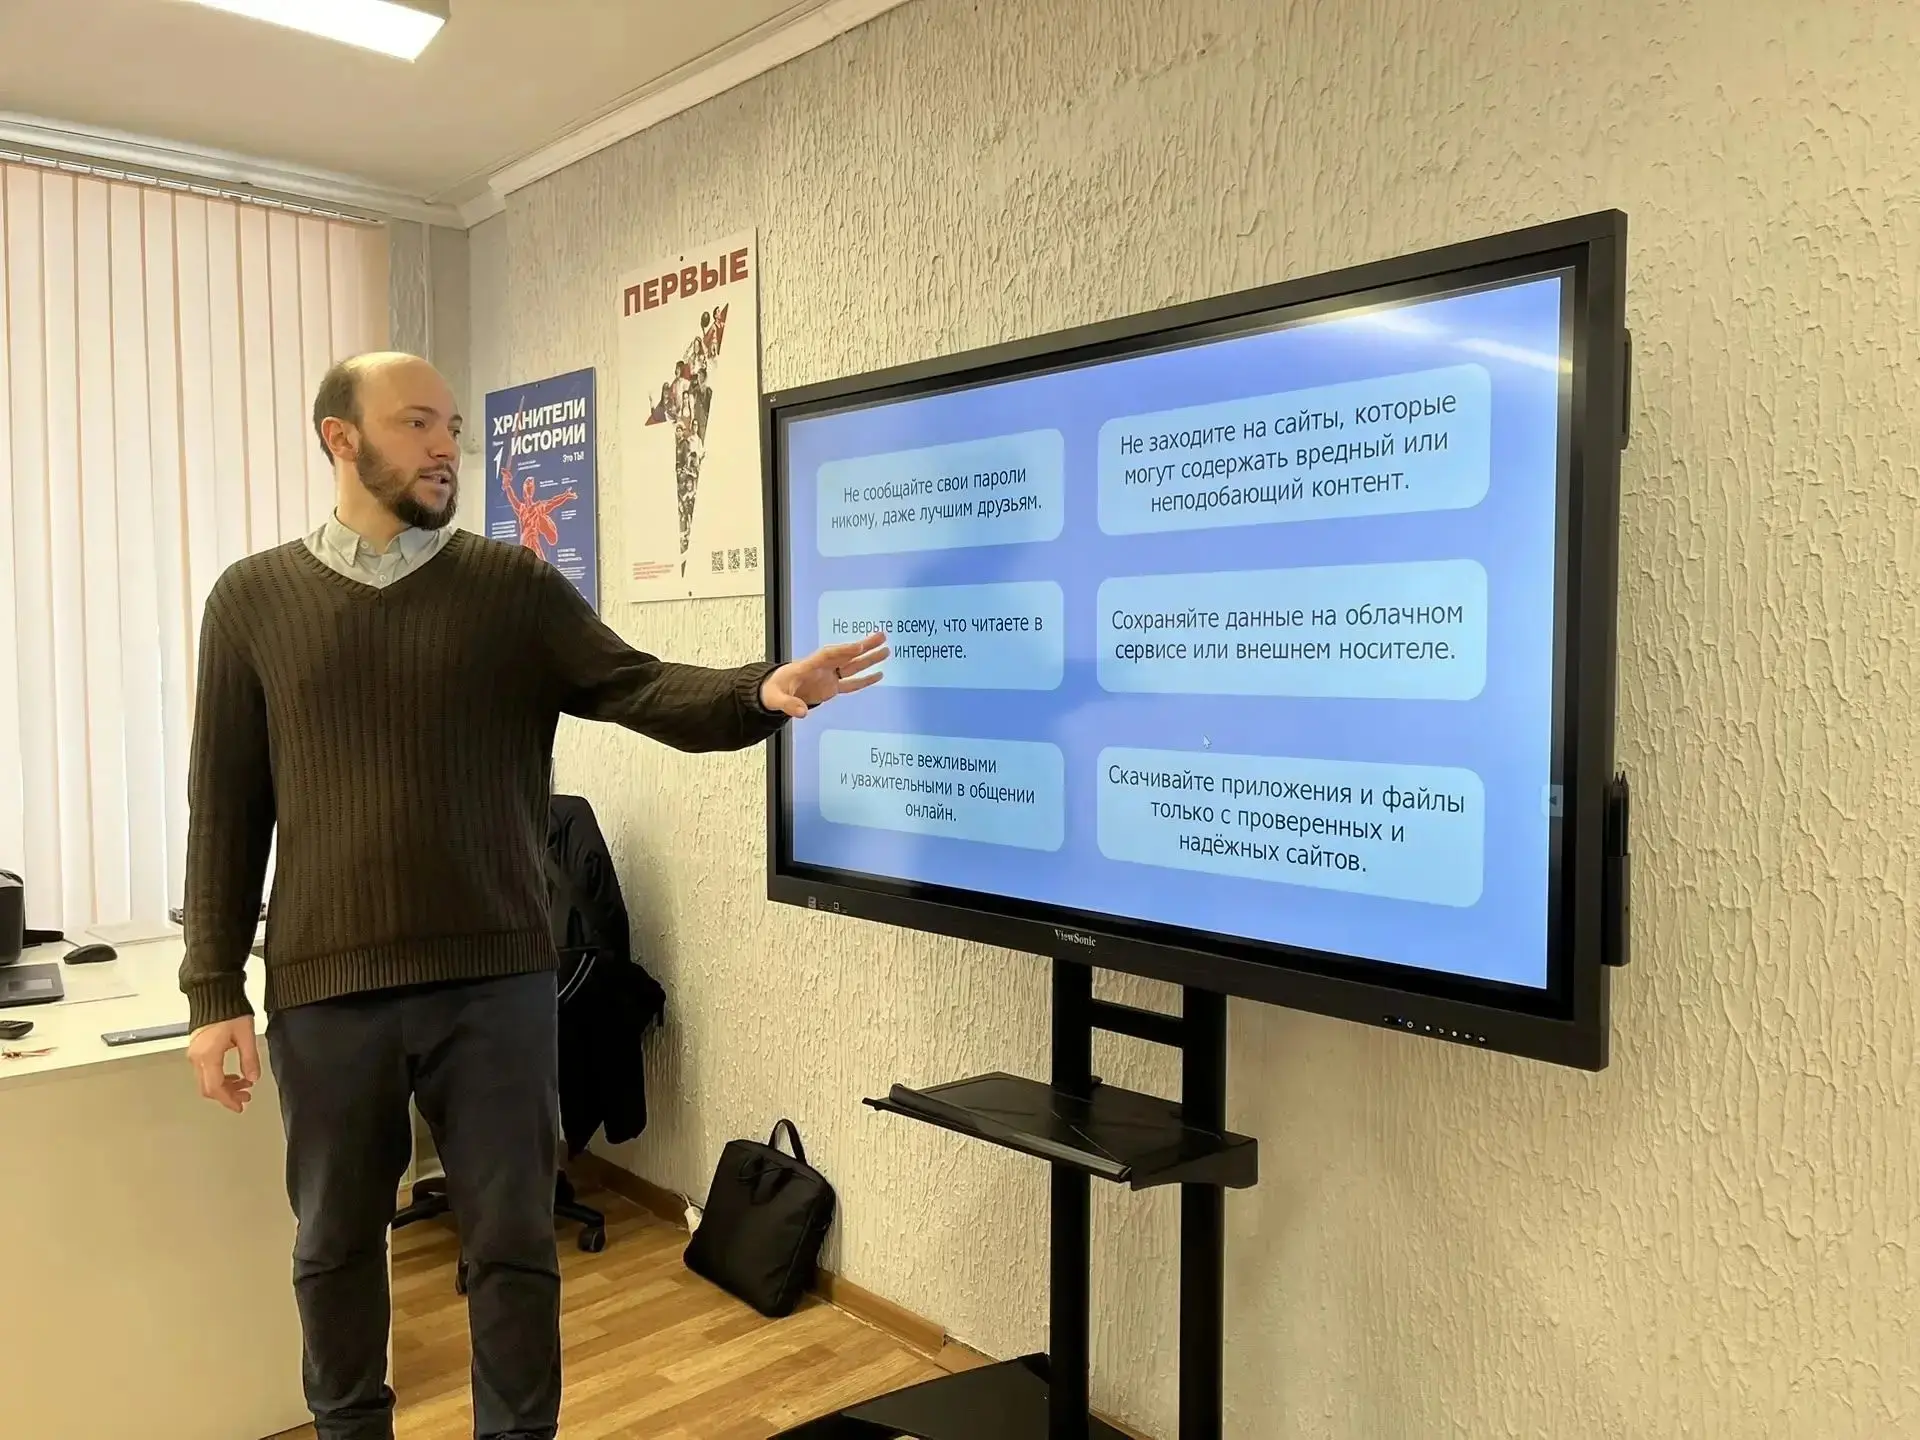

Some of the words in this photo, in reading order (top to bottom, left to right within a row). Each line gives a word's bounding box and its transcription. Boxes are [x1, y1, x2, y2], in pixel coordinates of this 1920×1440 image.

[624, 247, 748, 318] ПЕРВЫЕ
[492, 397, 586, 436] ХРАНИТЕЛИ
[1121, 434, 1144, 456] Не
[1149, 424, 1236, 453] заходите
[1243, 420, 1267, 440] на
[1274, 409, 1345, 436] сайты,
[1355, 394, 1457, 425] которые
[510, 422, 586, 458] ИСТОРИИ
[1125, 463, 1176, 488] могут
[1181, 451, 1289, 480] содержать
[1296, 432, 1395, 470] вредный
[1404, 431, 1448, 455] или
[844, 487, 860, 504] Не
[863, 478, 933, 503] сообщайте
[937, 476, 968, 493] свои
[973, 467, 1027, 492] пароли
[1151, 477, 1304, 513] неподобающий
[1312, 472, 1411, 498] контент.
[831, 512, 879, 530] никому,
[882, 508, 915, 527] даже
[919, 503, 973, 523] лучшим
[977, 495, 1042, 519] друзьям.
[832, 617, 848, 634] Не
[852, 619, 893, 636] верьте
[897, 619, 938, 638] всему,
[943, 618, 967, 633] что
[971, 616, 1029, 633] читаете
[1034, 617, 1043, 632] в
[1111, 608, 1219, 635] Сохраняйте
[1225, 608, 1304, 632] данные
[1311, 608, 1337, 627] на
[1345, 602, 1463, 626] облачном
[893, 642, 967, 661] интернете.
[1115, 643, 1187, 665] сервисе
[1193, 643, 1228, 660] или
[1236, 642, 1331, 660] внешнем
[1339, 641, 1456, 660] носителе.
[870, 748, 914, 768] Будьте
[917, 755, 997, 774] вежливыми
[840, 773, 848, 786] и
[851, 773, 953, 797] уважительными
[957, 783, 965, 797] в
[969, 783, 1036, 804] общении
[1108, 764, 1215, 793] Скачивайте
[1221, 777, 1352, 804] приложения
[1360, 787, 1373, 806] и
[1382, 784, 1465, 814] файлы
[905, 801, 957, 822] онлайн.
[1150, 801, 1215, 823] только
[1220, 808, 1232, 825] с
[1237, 809, 1383, 841] проверенных
[1391, 824, 1404, 843] и
[1179, 833, 1280, 862] надёжных
[1286, 844, 1367, 873] сайтов.
[1054, 928, 1096, 948] ViewSonic
